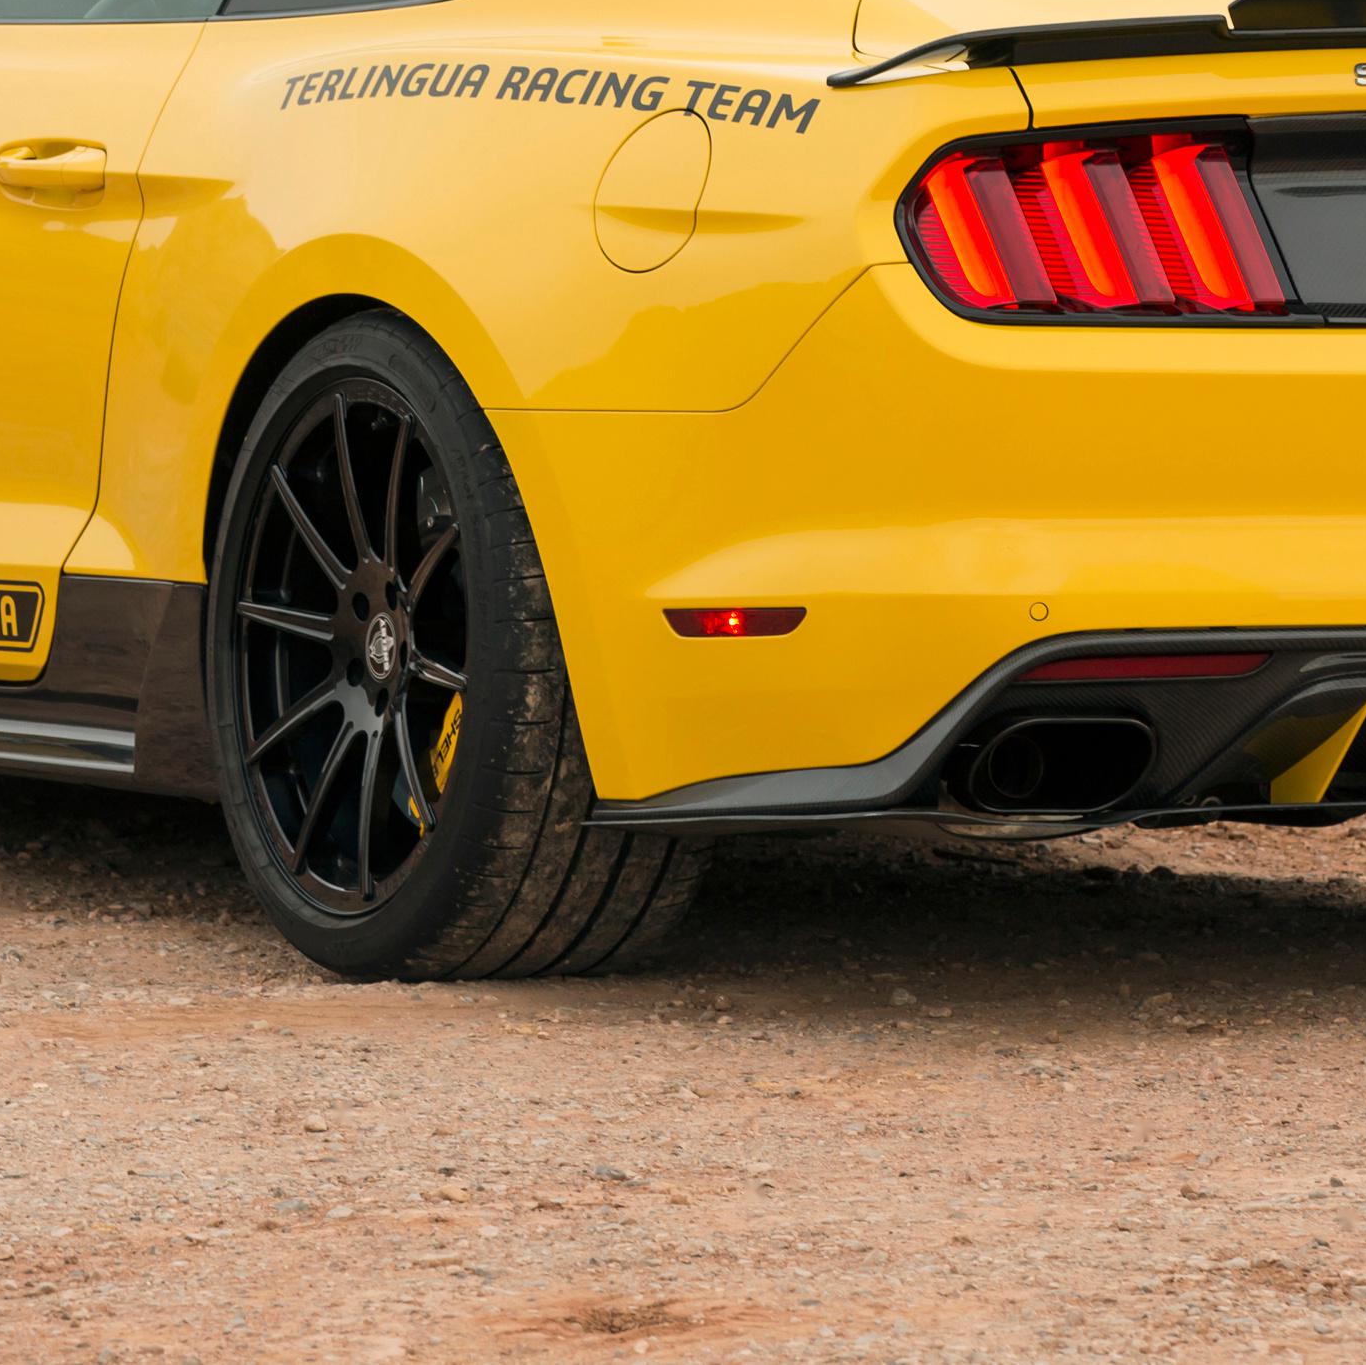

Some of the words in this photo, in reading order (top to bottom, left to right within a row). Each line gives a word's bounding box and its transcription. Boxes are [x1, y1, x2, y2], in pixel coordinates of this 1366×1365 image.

[280, 63, 490, 110] TERLINGUA
[496, 66, 670, 112] RACING
[684, 80, 821, 134] TEAM
[433, 708, 462, 776] SHEL
